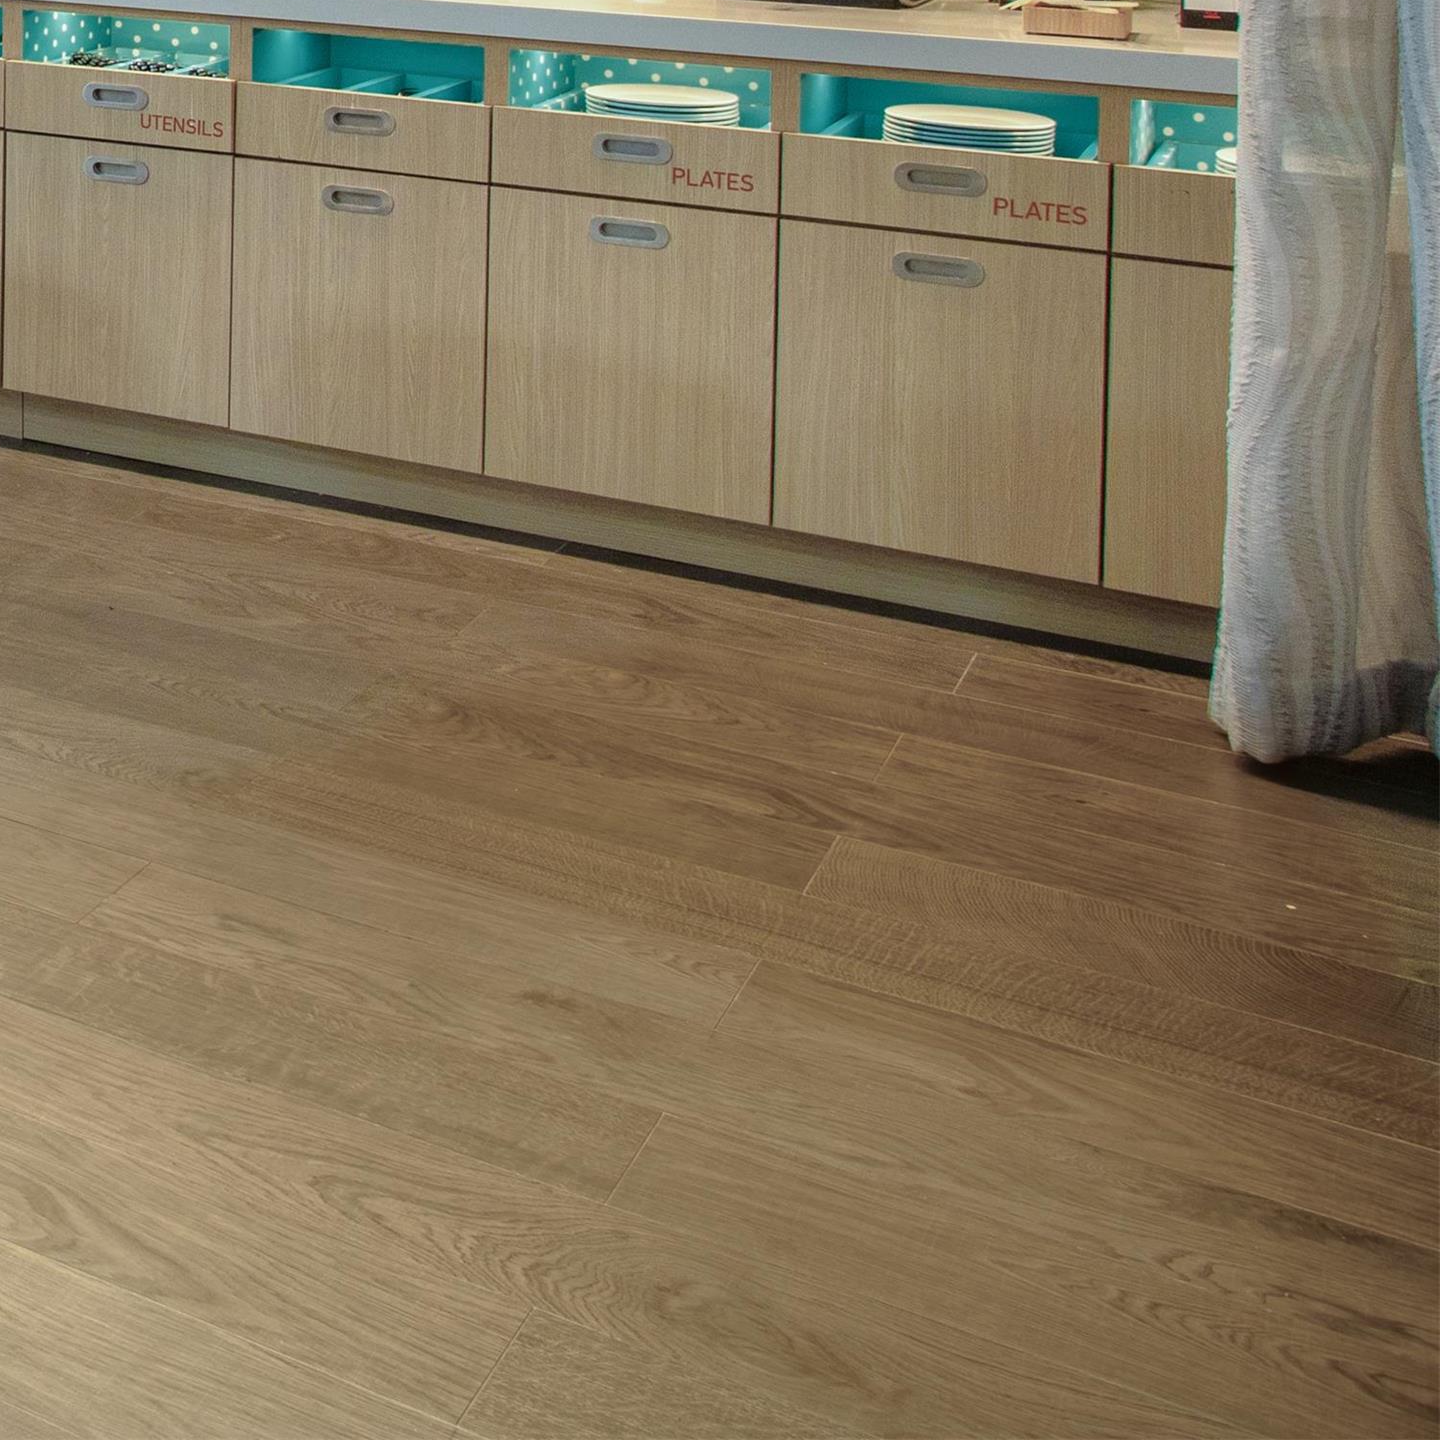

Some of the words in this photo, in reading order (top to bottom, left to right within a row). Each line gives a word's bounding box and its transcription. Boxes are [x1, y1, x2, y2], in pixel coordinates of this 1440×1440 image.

[140, 113, 224, 138] UTENSILS
[672, 166, 755, 192] PLATES
[993, 196, 1089, 226] PLATES
